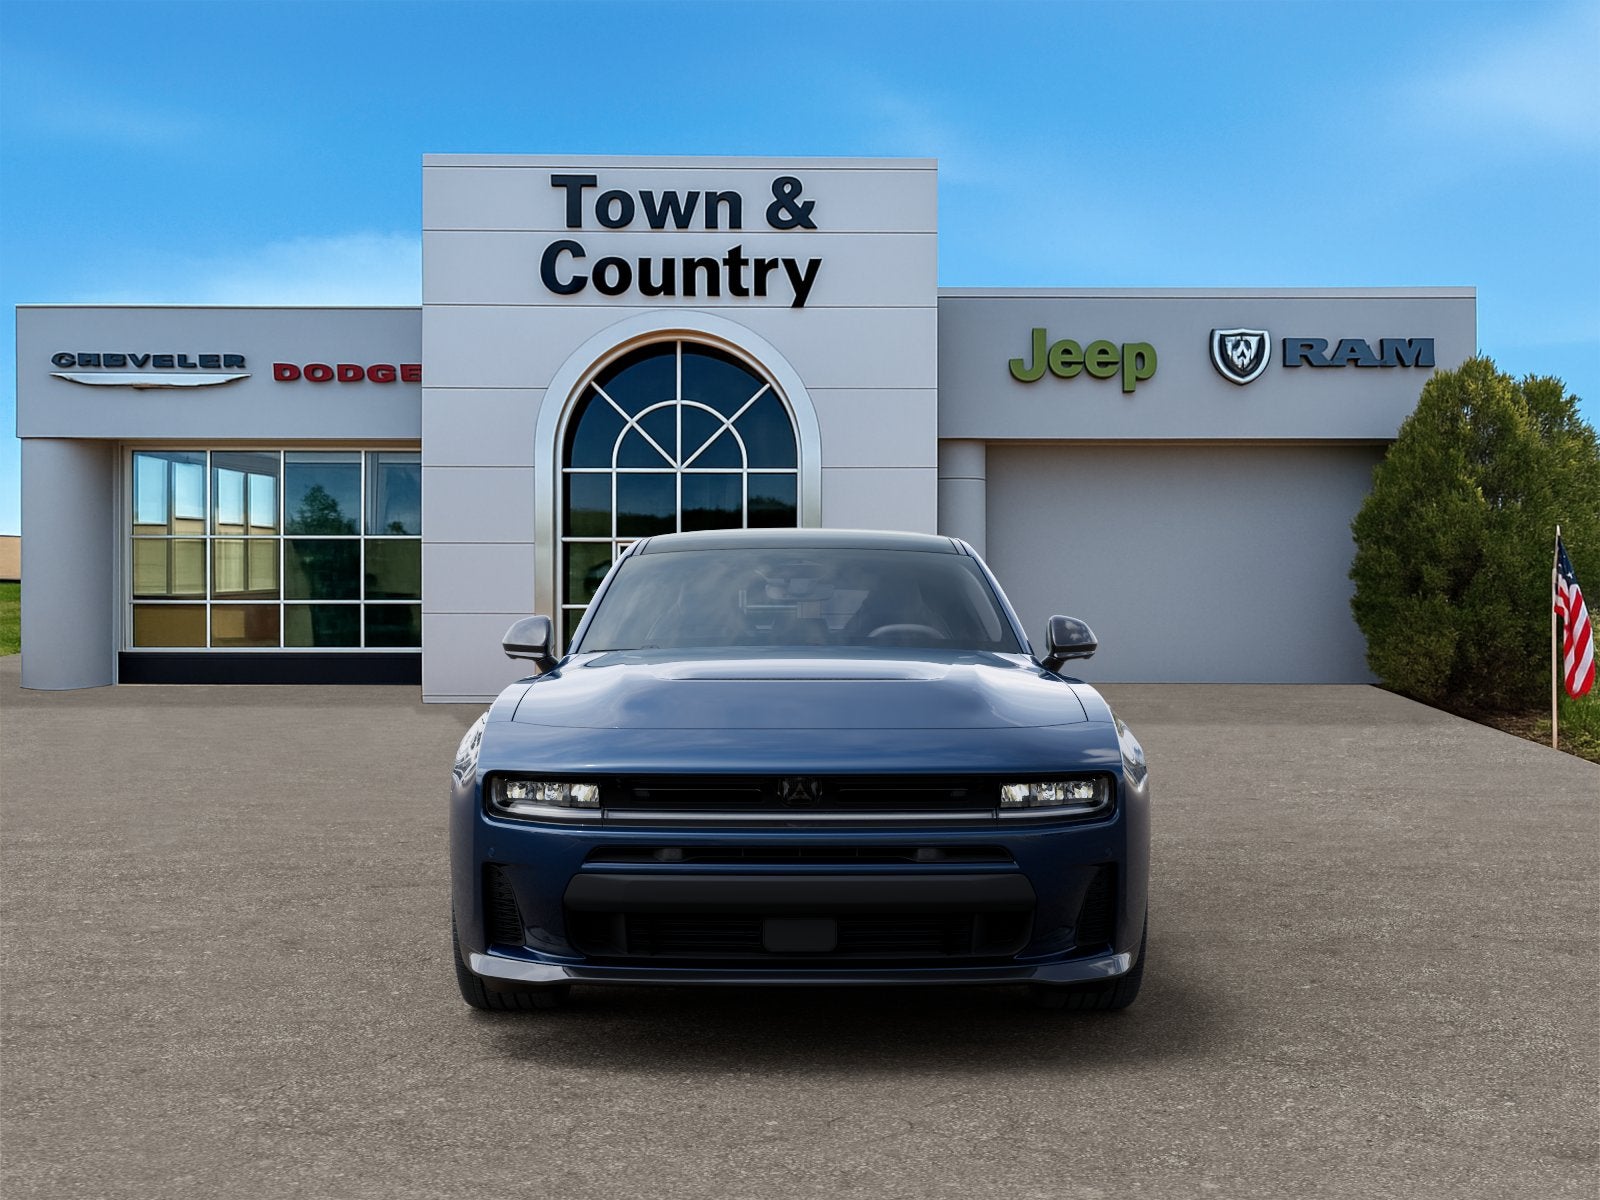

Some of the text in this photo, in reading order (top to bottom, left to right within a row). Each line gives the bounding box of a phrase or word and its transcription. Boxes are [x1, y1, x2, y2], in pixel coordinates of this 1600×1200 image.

[551, 174, 818, 229] Town &
[540, 239, 822, 308] Country
[273, 363, 422, 383] DODGE
[1009, 328, 1158, 393] Jeep
[1283, 338, 1436, 368] RAM
